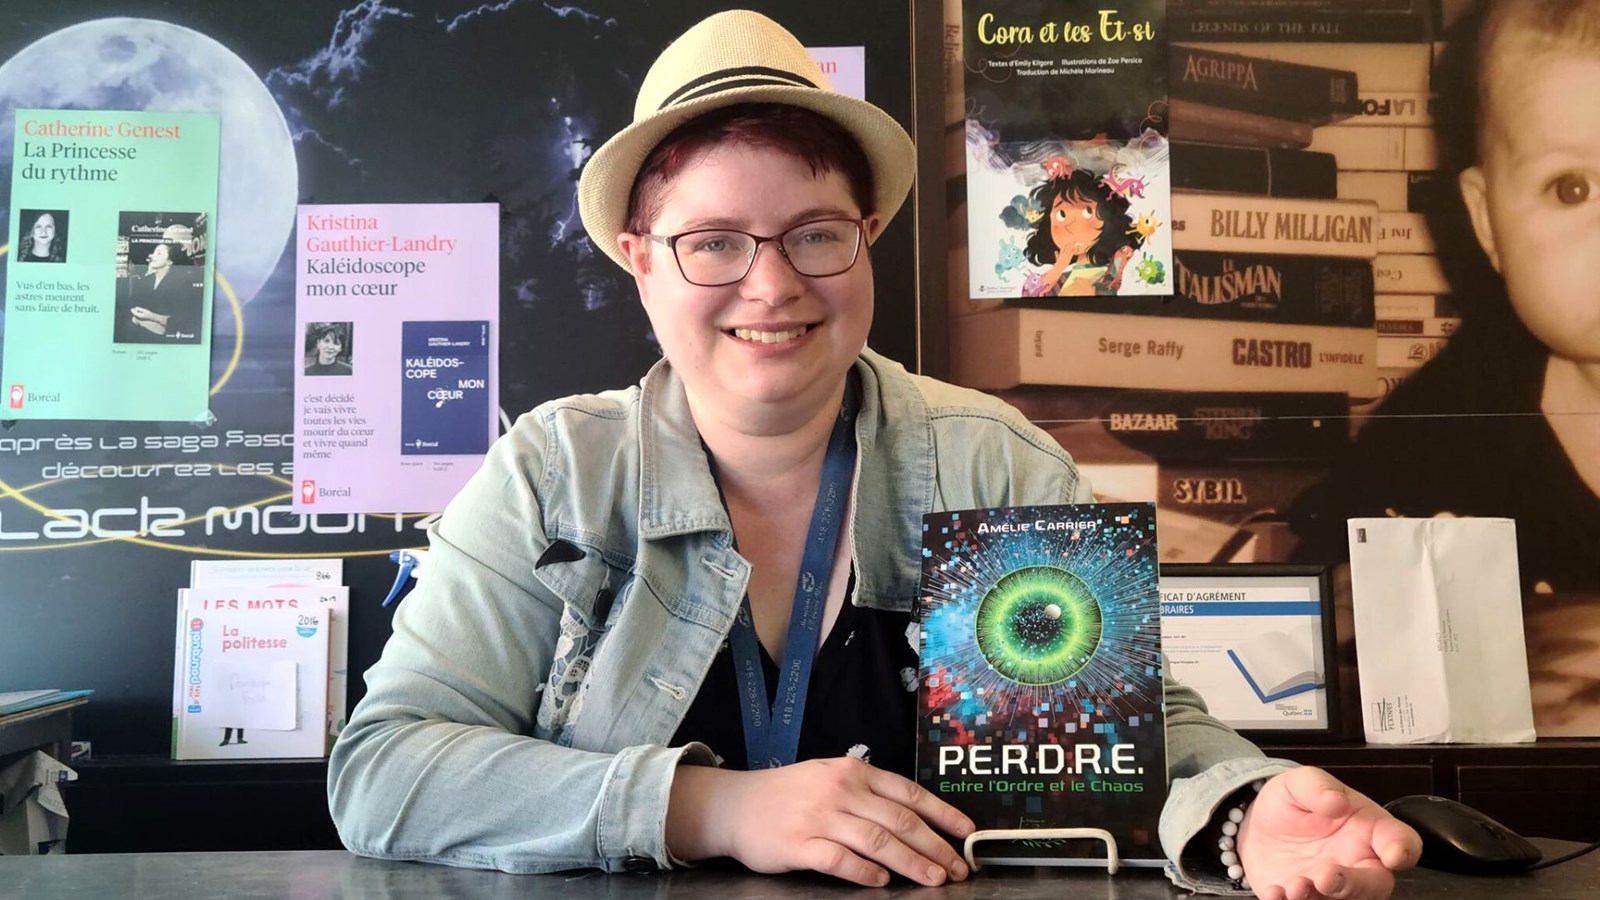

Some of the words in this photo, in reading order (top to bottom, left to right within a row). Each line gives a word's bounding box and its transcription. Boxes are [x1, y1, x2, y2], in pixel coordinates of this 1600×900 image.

[977, 13, 1034, 45] Cora
[1039, 21, 1059, 43] et
[1063, 21, 1093, 43] les
[1098, 10, 1155, 42] Et-si
[1191, 22, 1249, 33] LEGENDS
[1254, 22, 1271, 33] OF
[1279, 23, 1304, 34] THE
[1311, 23, 1339, 34] FALL
[1009, 60, 1031, 68] d'Emily
[1032, 60, 1054, 68] Kilgore
[1061, 58, 1097, 66] Illustrations
[1098, 57, 1106, 65] de
[1182, 54, 1259, 92] AGRIPPA
[23, 119, 114, 138] Catherine
[117, 121, 182, 139] Genest
[23, 142, 46, 158] La
[51, 142, 137, 160] Princesse
[22, 163, 46, 180] du
[50, 164, 118, 184] rythme
[307, 214, 378, 231] Kristina
[1210, 209, 1269, 239] BILLY
[1273, 212, 1373, 244] MILLIGAN
[306, 235, 457, 256] Gauthier-Landry
[307, 257, 426, 278] Kaléidoscope
[16, 281, 34, 290] Vus
[36, 281, 55, 290] d'en
[57, 281, 76, 291] bas,
[77, 282, 90, 291] les
[1174, 254, 1283, 306] TALISMAN
[306, 284, 346, 296] mon
[351, 283, 398, 296] cœur
[15, 293, 43, 301] astres
[45, 294, 85, 302] meurent
[38, 303, 60, 312] faire
[61, 304, 73, 312] de
[74, 304, 100, 313] bruit.
[1098, 338, 1141, 358] Serge
[1147, 340, 1184, 360] Raffy
[1232, 338, 1312, 369] CASTRO
[405, 369, 437, 379] COPE
[458, 379, 485, 389] MON
[28, 392, 61, 402] Boréal
[303, 394, 323, 403] c'est
[324, 393, 355, 403] décidé
[303, 406, 312, 416] je
[313, 406, 332, 414] vais
[334, 405, 357, 414] vivre
[1194, 407, 1262, 426] STEPHEN
[303, 417, 332, 425] toutes
[333, 416, 346, 425] les
[348, 416, 367, 425] vies
[1110, 413, 1178, 431] BAZAAR
[303, 428, 335, 436] mourir
[337, 427, 349, 436] du
[1205, 424, 1251, 440] KING
[144, 435, 219, 453] saga
[314, 438, 337, 447] vivre
[338, 438, 368, 450] quand
[303, 449, 332, 459] même
[42, 462, 212, 479] découvrez
[319, 487, 351, 497] Boréal
[1173, 478, 1248, 504] SYBIL
[1160, 592, 1184, 601] FICAT
[1186, 590, 1246, 601] D'AGRÉMENT
[248, 599, 298, 609] MOTS
[1160, 605, 1194, 614] BRAIRES
[297, 614, 319, 626] 2016
[223, 624, 239, 636] La
[222, 636, 288, 653] politesse
[189, 631, 203, 685] pourquoi
[938, 743, 1144, 775] P.E.R.D.R.E.
[939, 781, 984, 792] Entre
[989, 780, 1044, 792] l'Ordre
[1050, 781, 1065, 791] et
[1071, 780, 1085, 791] le
[1090, 780, 1144, 792] Chaos
